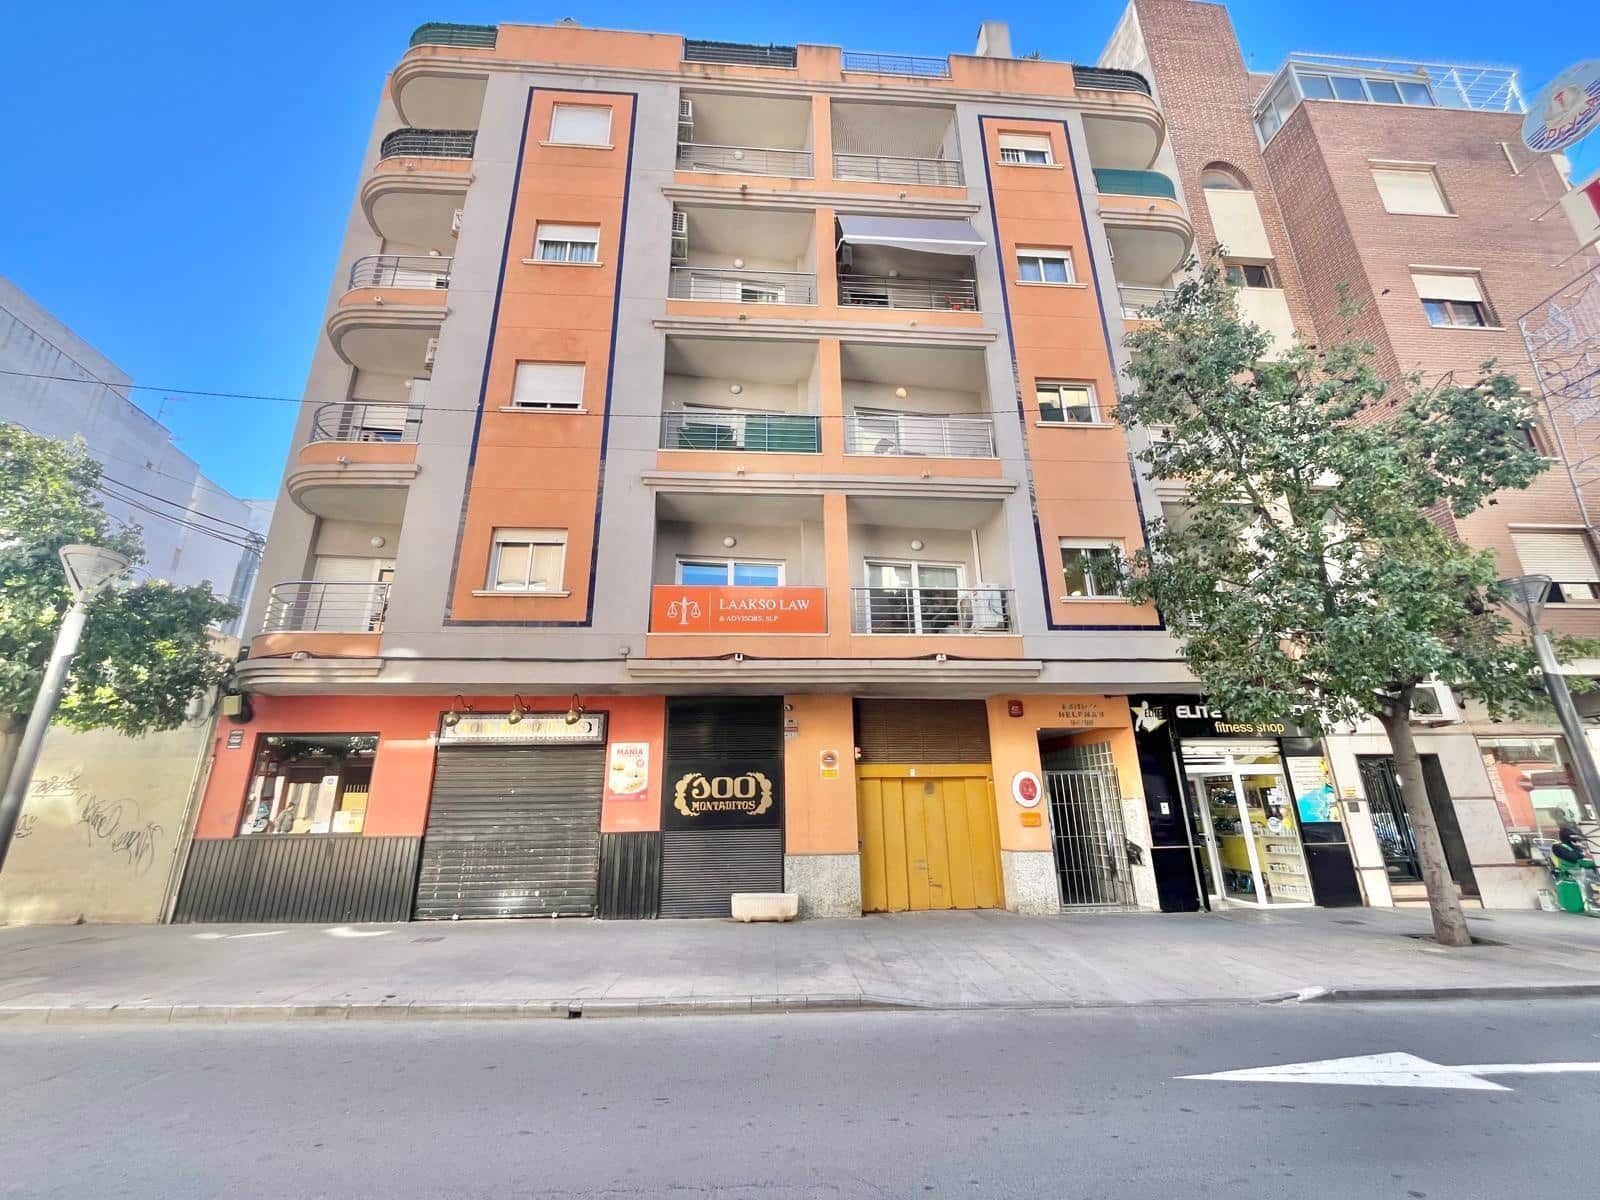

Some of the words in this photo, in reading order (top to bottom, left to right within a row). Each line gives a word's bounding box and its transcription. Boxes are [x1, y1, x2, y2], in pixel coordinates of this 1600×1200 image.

[719, 598, 776, 610] LAAKSO
[779, 599, 810, 610] LAW
[1214, 721, 1253, 733] fitness
[1256, 722, 1286, 735] shop
[691, 800, 756, 811] MONTADITOS
